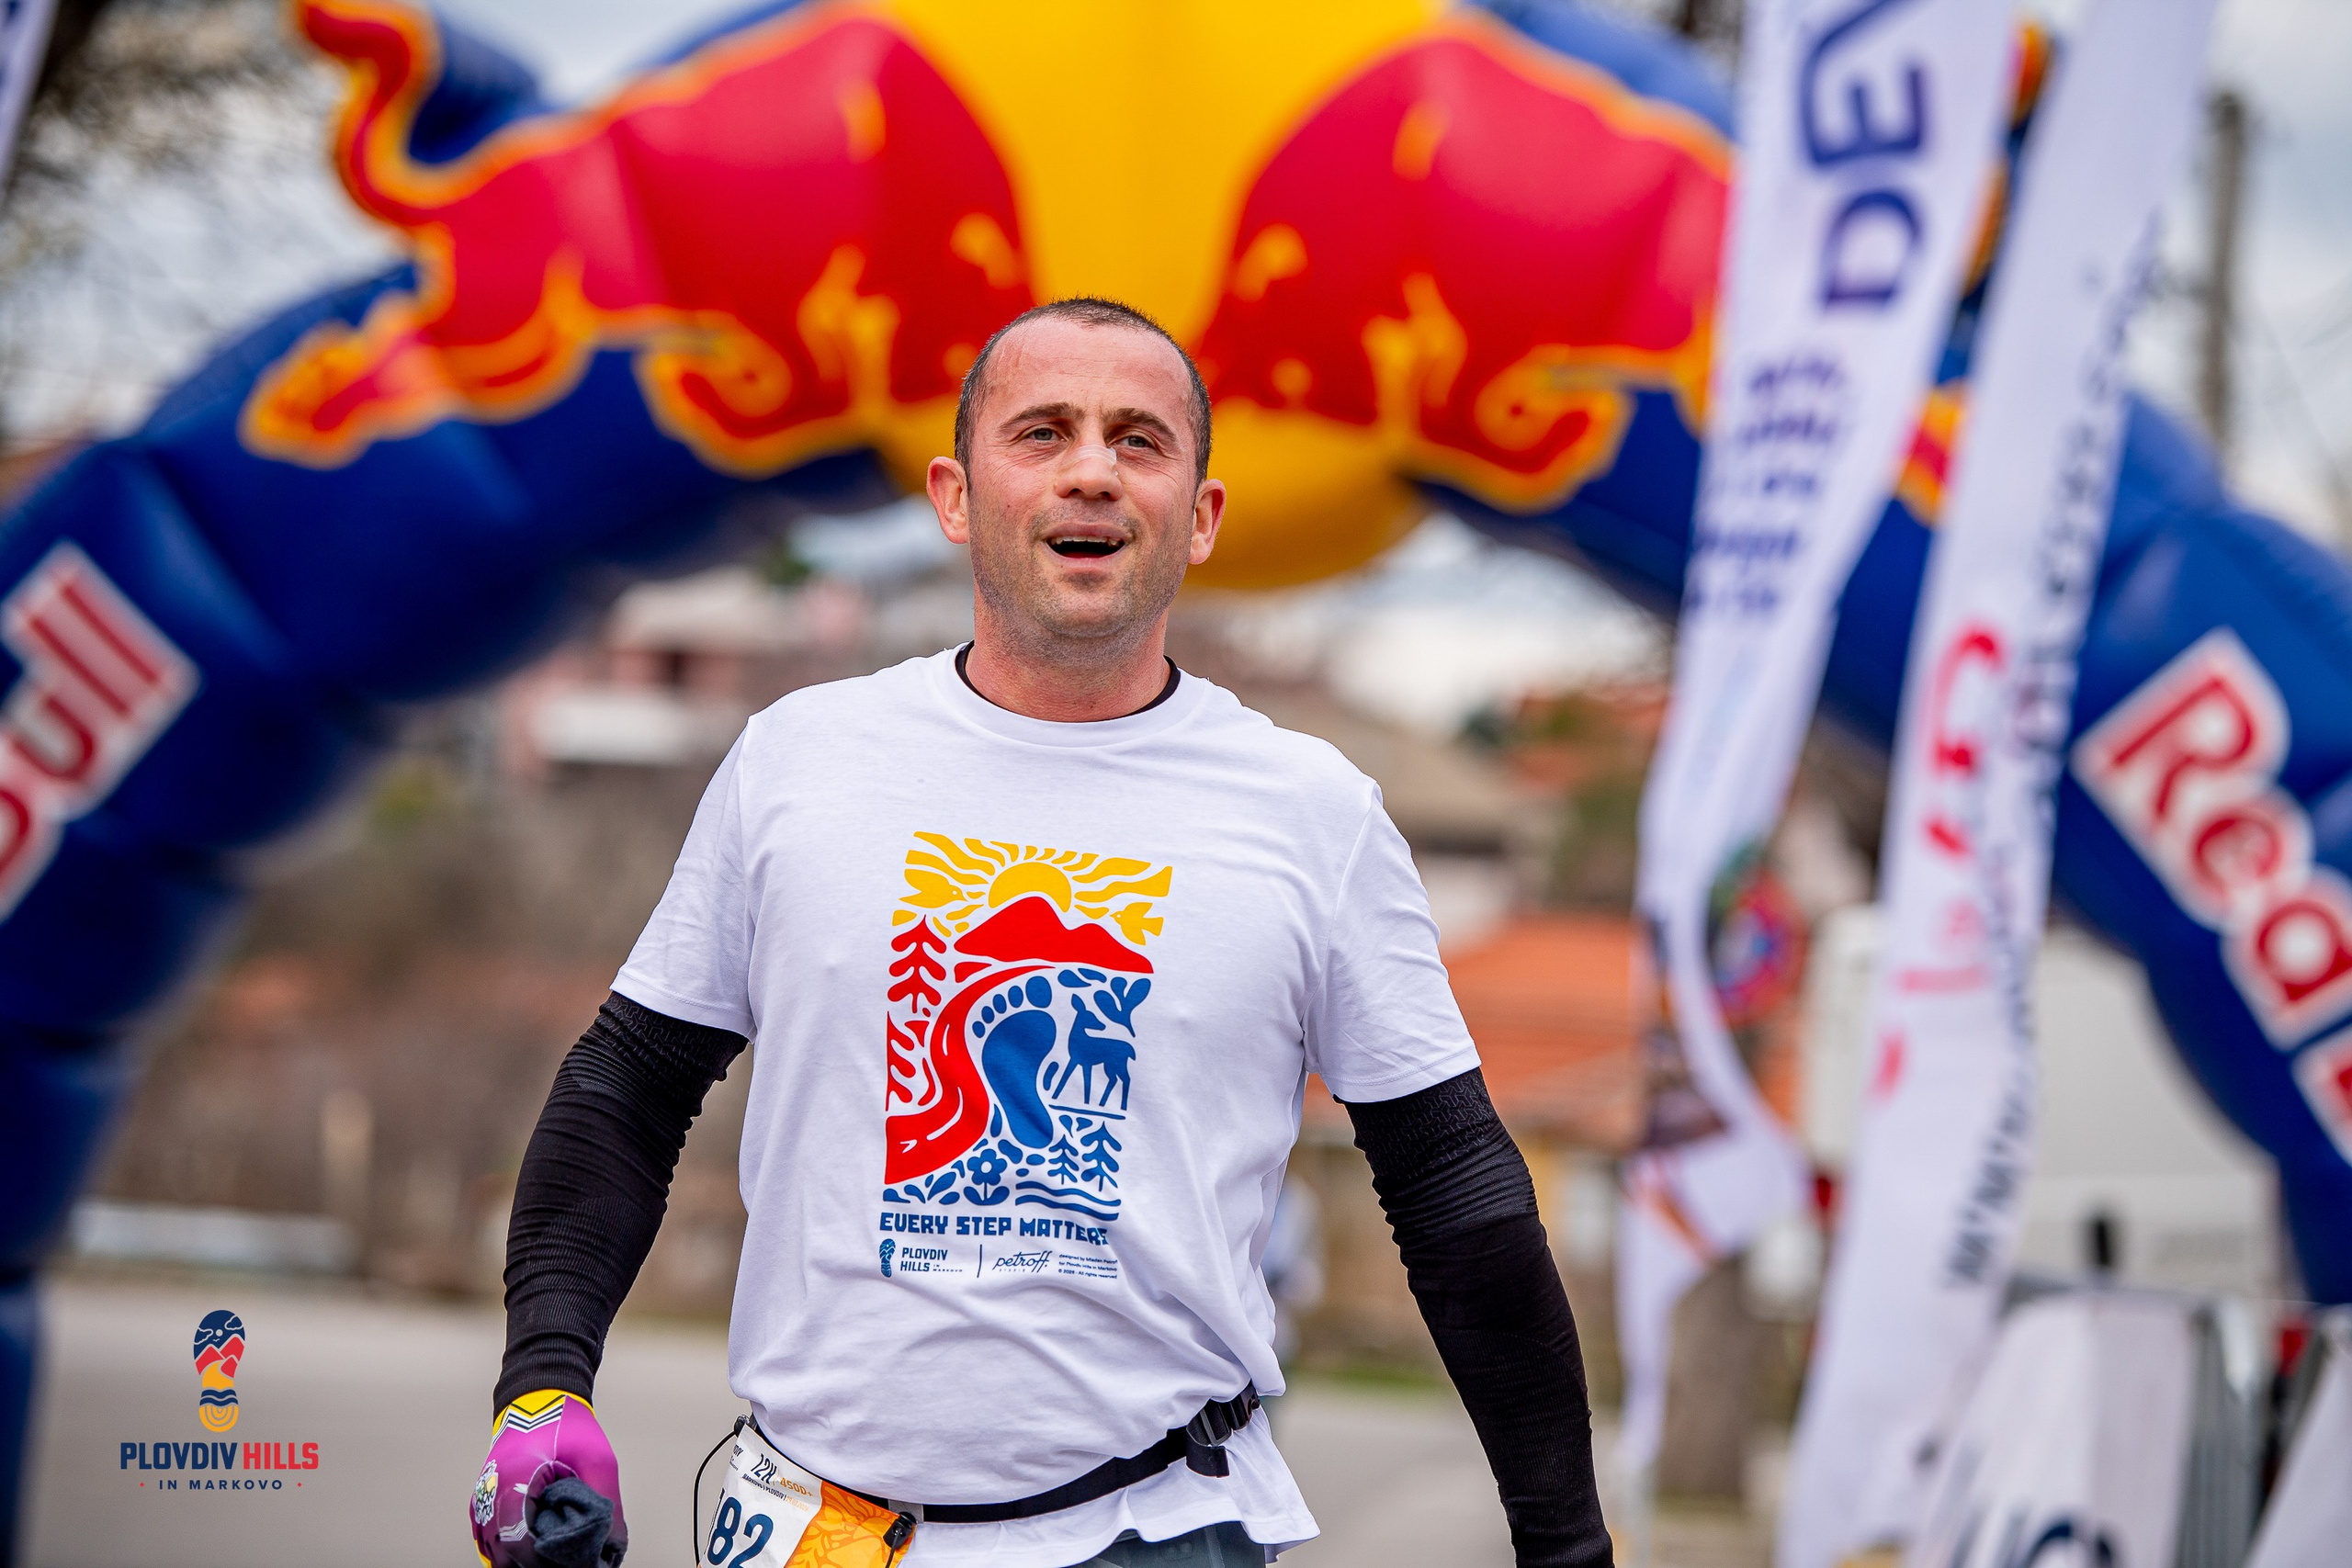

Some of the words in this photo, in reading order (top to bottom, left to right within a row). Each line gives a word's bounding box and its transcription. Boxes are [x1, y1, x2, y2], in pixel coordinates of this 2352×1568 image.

[879, 1212, 949, 1235] EVERY
[956, 1216, 1012, 1235] STEP
[1020, 1217, 1108, 1246] MATTERS
[901, 1247, 948, 1260] PLOVDIV
[900, 1261, 931, 1272] HILLS
[704, 1487, 774, 1568] 82
